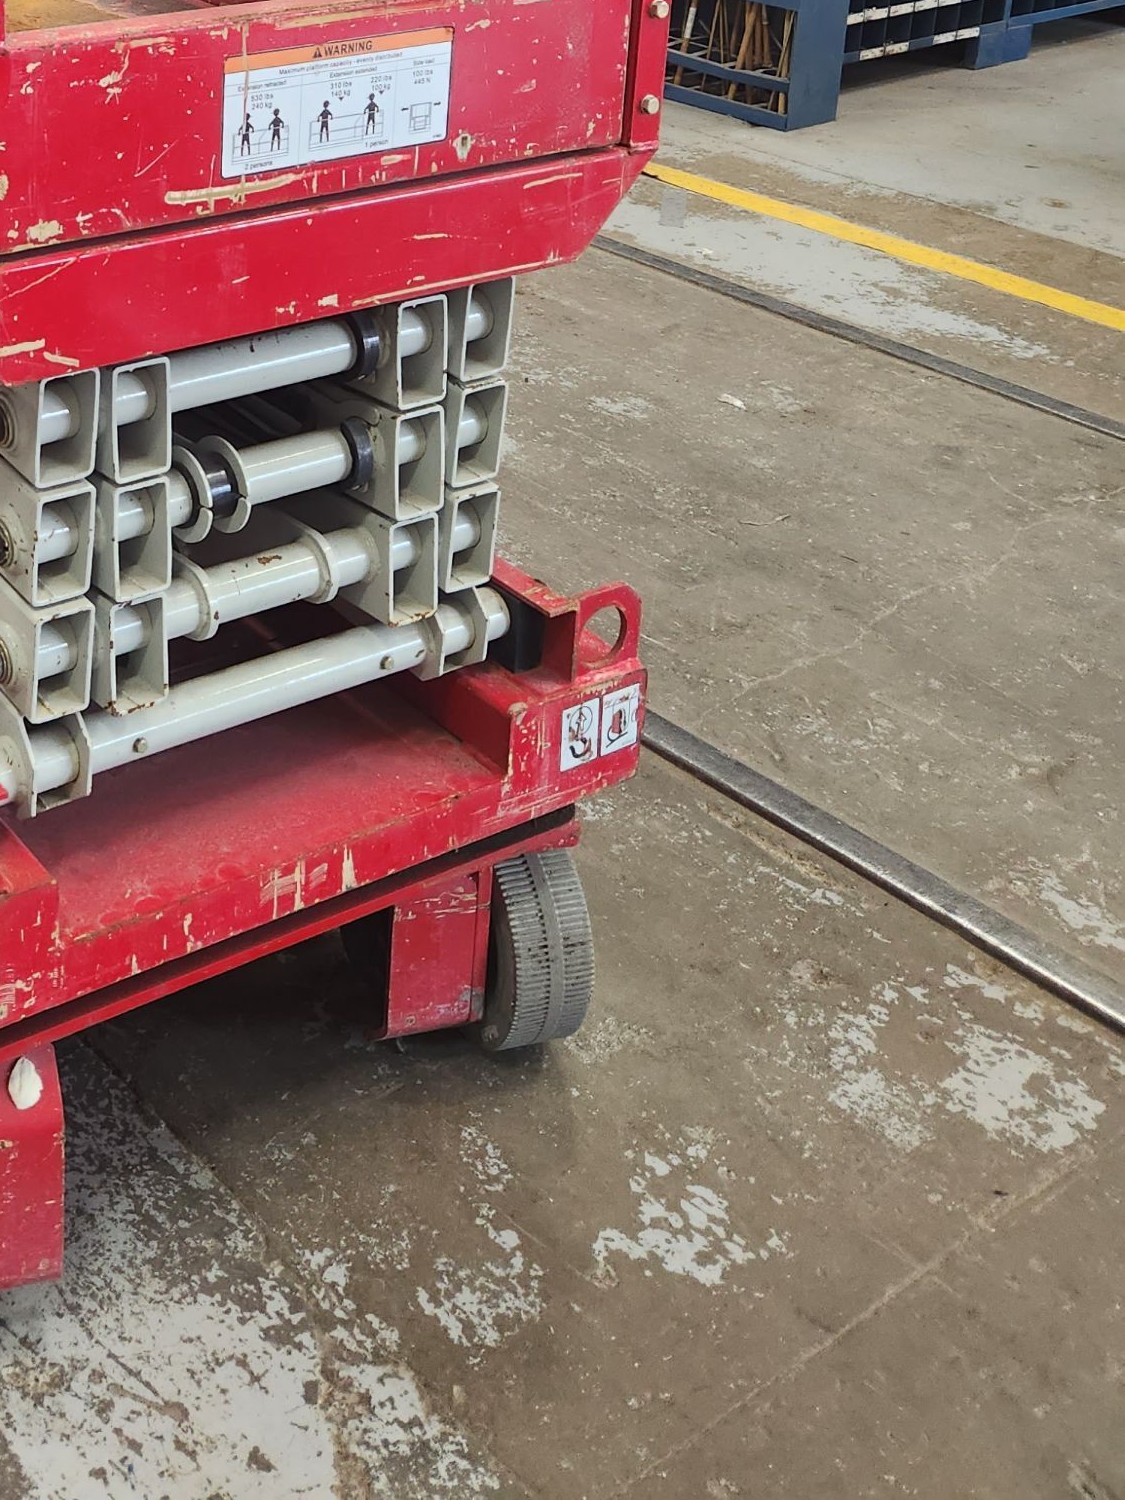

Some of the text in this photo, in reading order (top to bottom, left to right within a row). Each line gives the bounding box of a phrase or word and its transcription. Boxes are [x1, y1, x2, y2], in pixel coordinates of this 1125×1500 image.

[324, 40, 373, 57] WARNING
[279, 65, 304, 75] Maximum
[305, 61, 329, 73] platform
[330, 80, 352, 90] 310 lbs
[251, 101, 273, 111] 240 kg
[370, 138, 389, 148] person
[249, 161, 273, 171] persons
